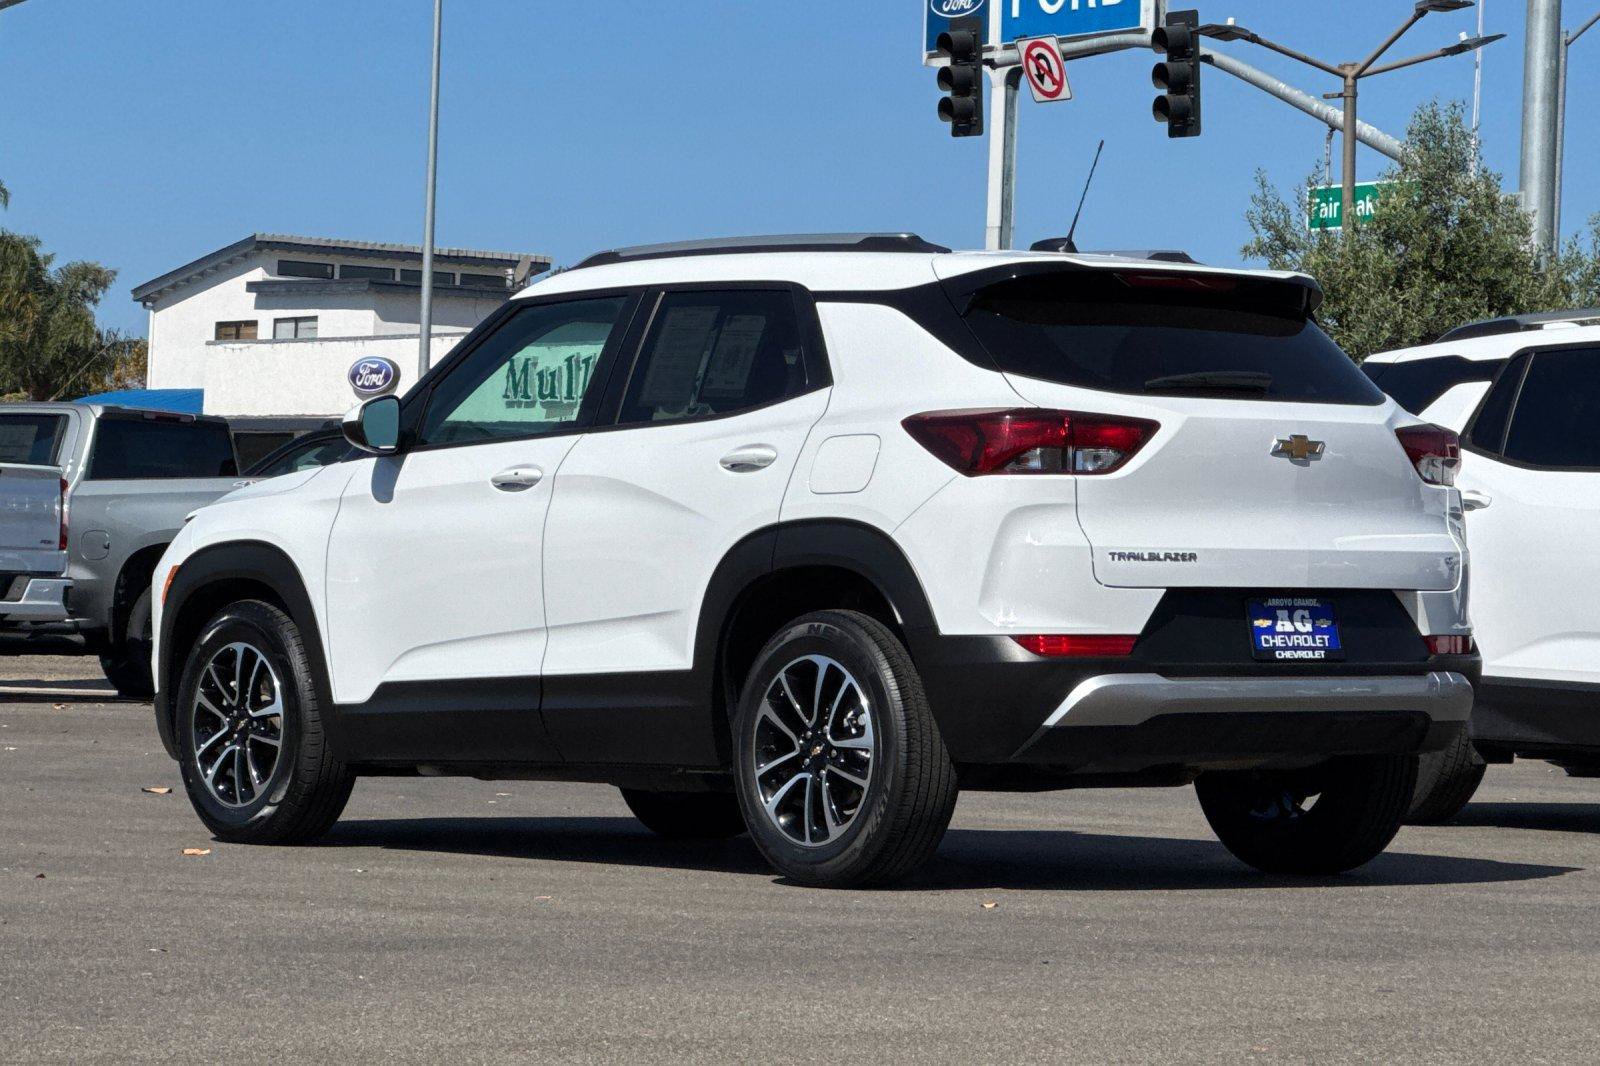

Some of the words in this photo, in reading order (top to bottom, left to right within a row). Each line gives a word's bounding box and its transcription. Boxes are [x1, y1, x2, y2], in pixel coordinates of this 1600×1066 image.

[355, 362, 386, 387] Ford
[1108, 551, 1198, 563] TRAILBLAZER
[1267, 598, 1293, 607] ARROYO
[1293, 598, 1319, 607] GRANDE
[1275, 609, 1313, 633] AG
[1261, 634, 1330, 648] CHEVROLET
[1275, 650, 1326, 659] CHEVROLET
